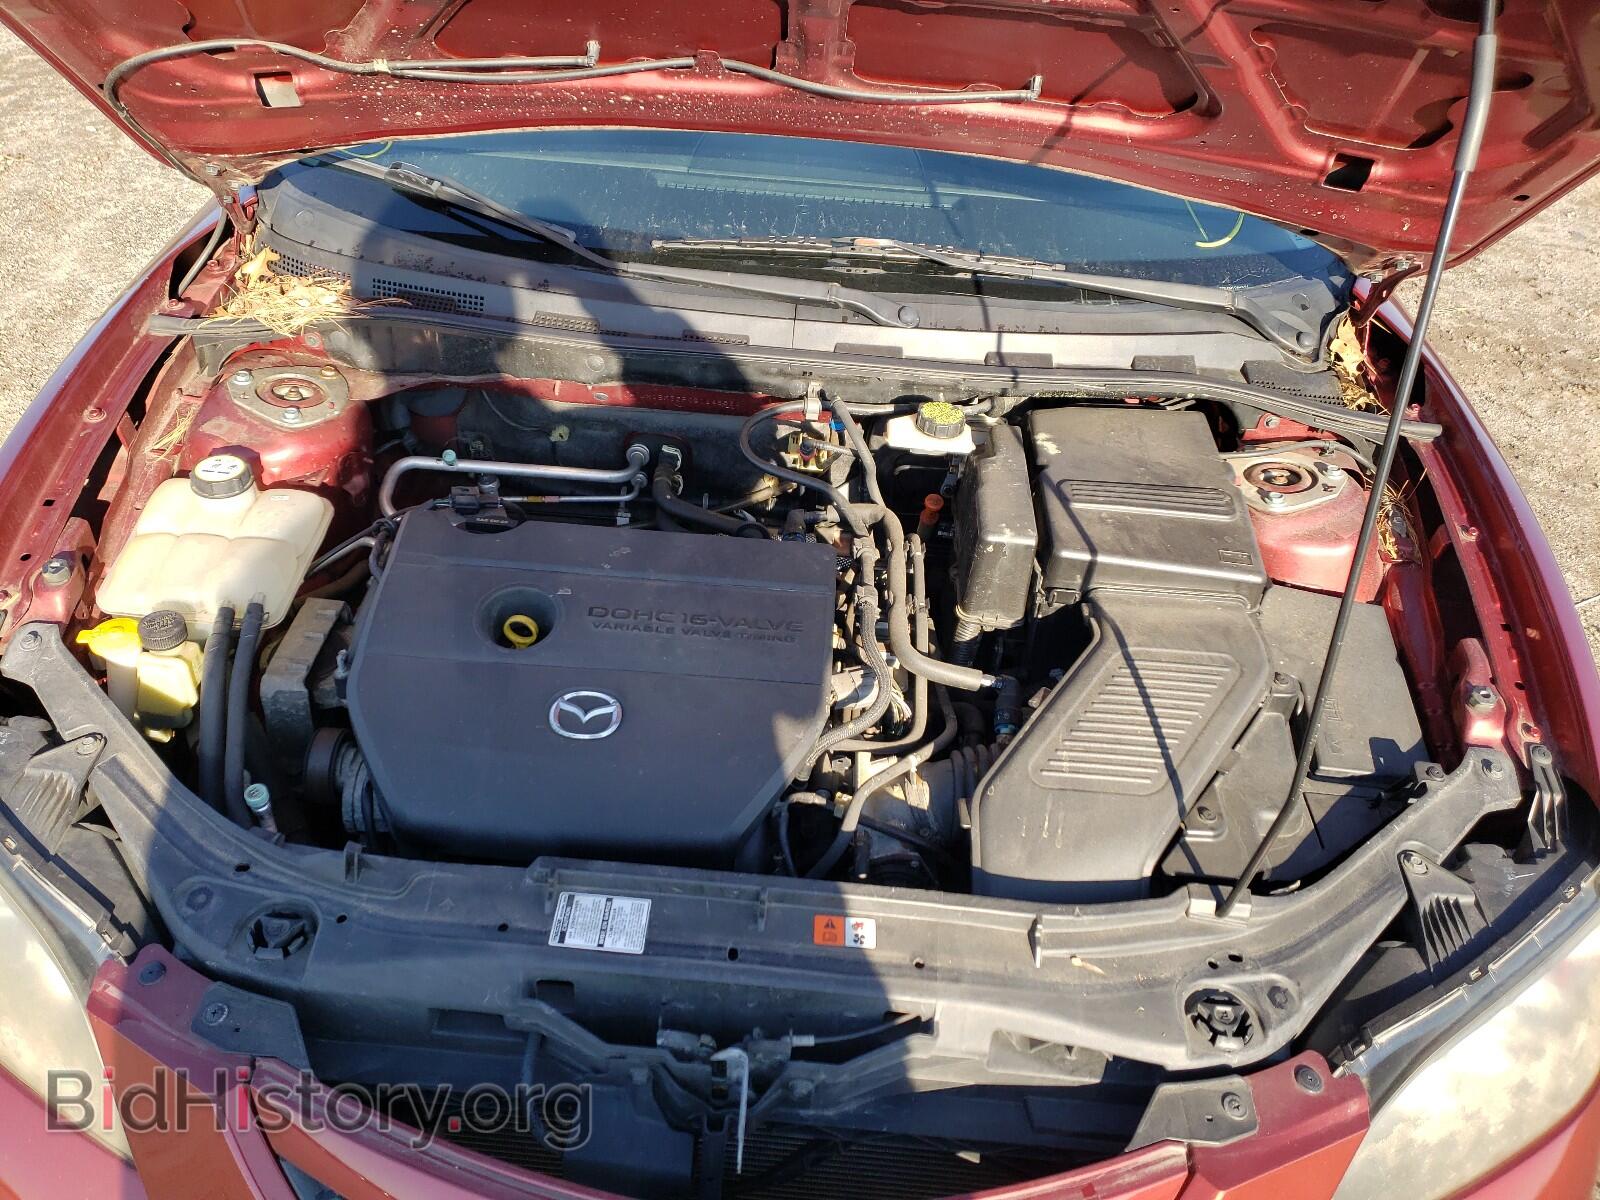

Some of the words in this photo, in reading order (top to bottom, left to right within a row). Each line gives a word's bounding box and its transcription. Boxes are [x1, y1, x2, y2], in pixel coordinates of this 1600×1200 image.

[587, 606, 675, 623] DOHC
[681, 612, 804, 632] 16-VALVE
[592, 621, 675, 635] VARIABLE
[681, 627, 731, 639] VALVE
